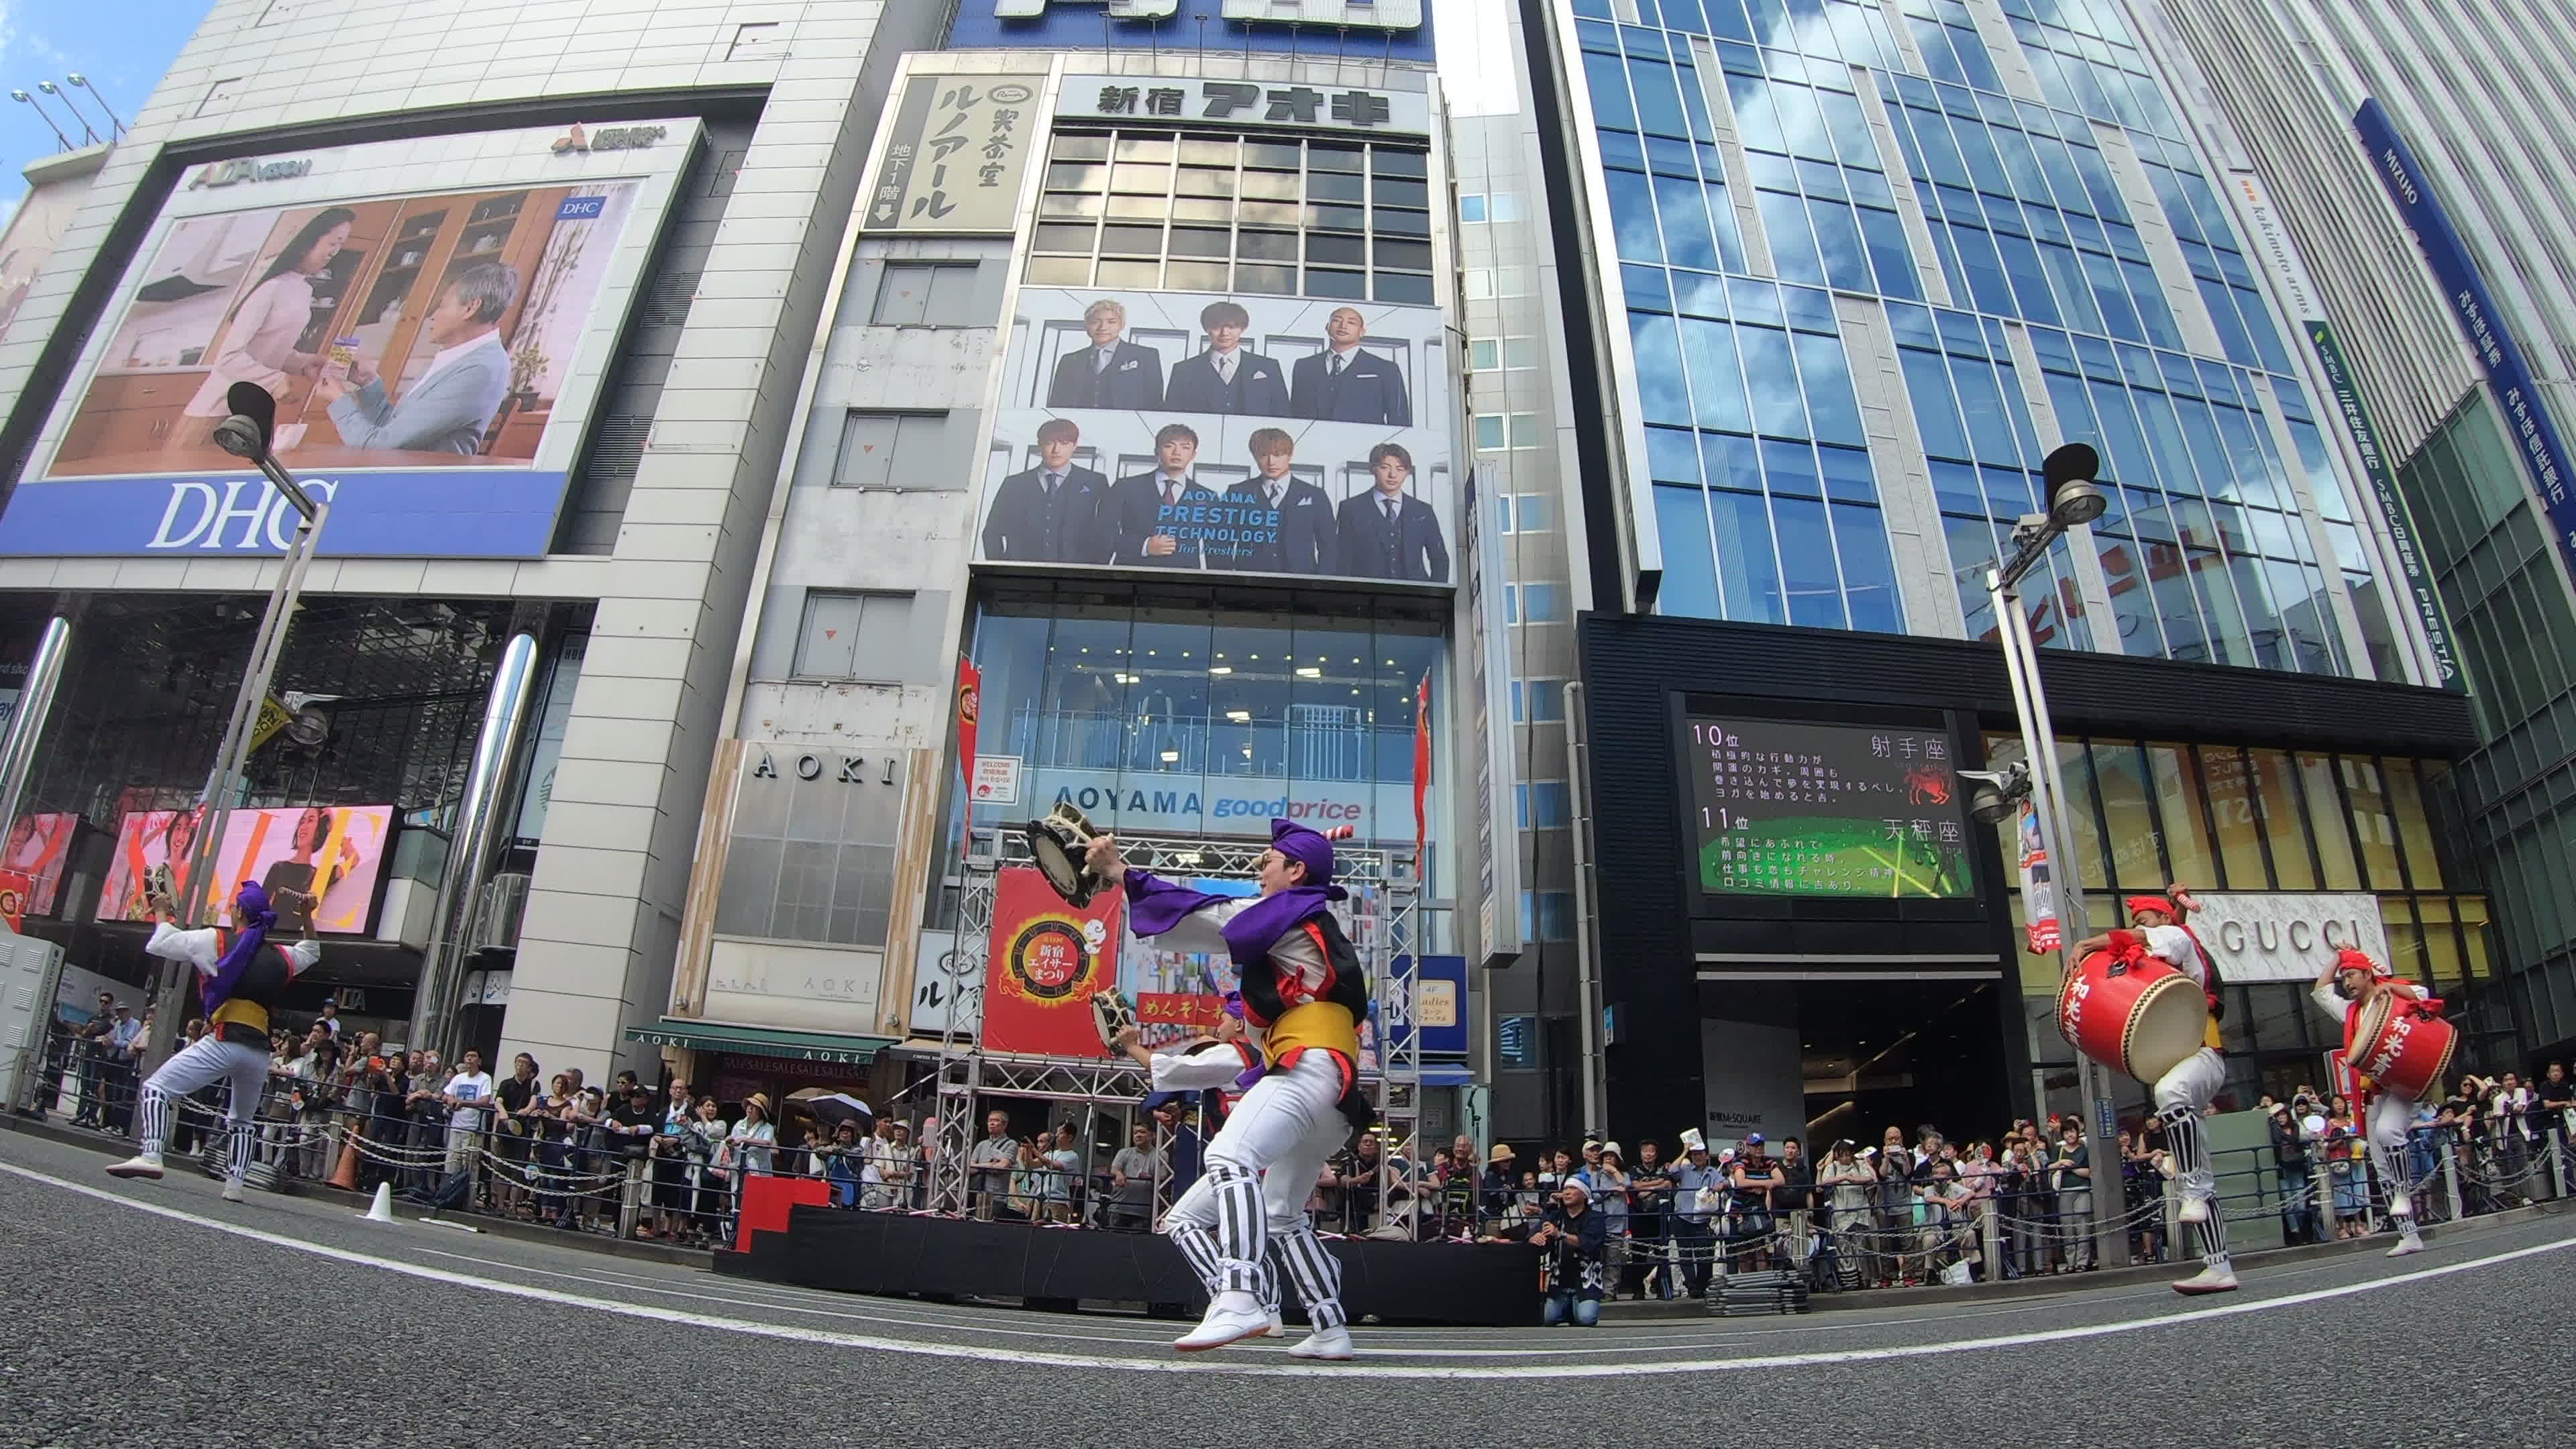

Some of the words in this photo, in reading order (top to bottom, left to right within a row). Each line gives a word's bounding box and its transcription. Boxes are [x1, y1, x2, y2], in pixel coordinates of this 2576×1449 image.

[1096, 82, 1389, 125] 新宿アオキ
[910, 85, 983, 219] ルノアール
[979, 109, 1019, 187] 喫茶室
[879, 144, 912, 200] 地下1階
[2383, 148, 2418, 205] MIZUHO
[562, 202, 600, 216] DHC
[2252, 206, 2291, 272] kakimoto
[2286, 276, 2310, 314] arms
[2458, 289, 2501, 368] みずほ証券
[2320, 345, 2343, 384] SMBC
[2338, 390, 2379, 469] 三井住友銀行
[2506, 387, 2565, 504] みずほ信託銀行
[1185, 490, 1256, 503] AOYAMA
[145, 478, 339, 550] DHC
[1158, 504, 1280, 527] PRESTIGE
[1179, 543, 1197, 553] for
[1693, 724, 1739, 747] 10位
[1872, 735, 1945, 760] 射手座
[753, 751, 896, 785] AOKI
[1055, 786, 1202, 814] AOYAMA
[1702, 807, 1749, 830] 11位
[1883, 818, 1960, 843] 天秤座
[2220, 920, 2361, 953] GUCCI
[1028, 959, 1073, 969] エイサー
[1040, 945, 1064, 958] 新宿
[804, 977, 870, 994] AOKI
[1034, 969, 1064, 981] まつり
[637, 1034, 688, 1049] AOKI
[804, 1050, 859, 1063] AOKI
